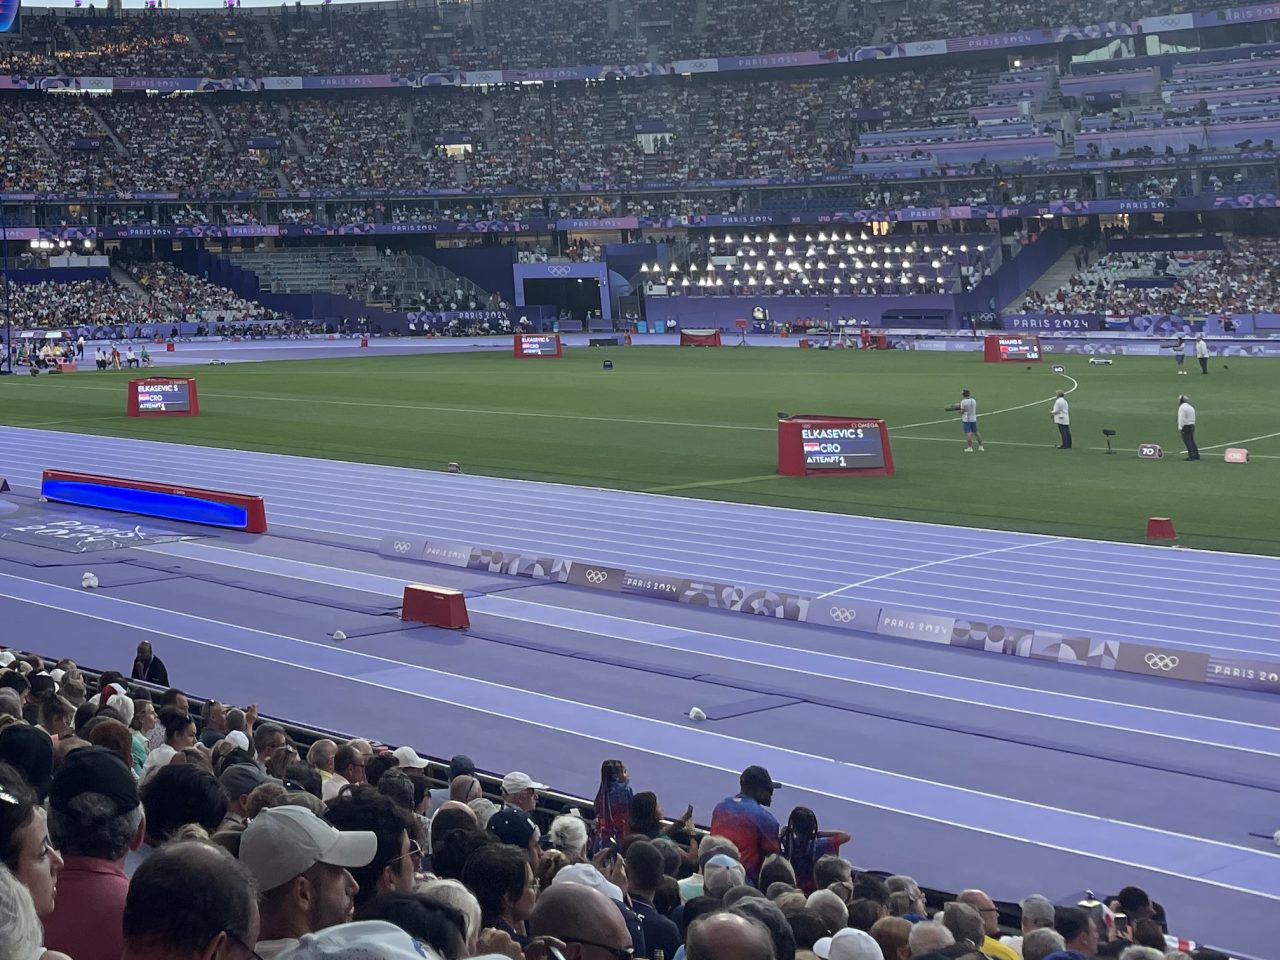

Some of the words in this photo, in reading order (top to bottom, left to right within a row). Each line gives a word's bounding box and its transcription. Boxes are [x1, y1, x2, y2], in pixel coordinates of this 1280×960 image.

[968, 38, 1002, 48] PARIS
[1004, 35, 1032, 45] 2024
[1120, 202, 1148, 210] PARIS
[460, 312, 483, 320] PARIS
[485, 311, 507, 319] 2024
[1014, 320, 1050, 328] PARIS
[1054, 320, 1088, 328] 2024
[138, 385, 172, 393] ELKASEVIC
[173, 384, 178, 392] S
[149, 394, 162, 402] CRO
[801, 428, 856, 439] ELKASEVIC
[857, 428, 864, 438] S
[820, 443, 841, 453] CRO
[806, 456, 839, 464] ATTEMPT
[840, 456, 846, 467] 1
[427, 547, 446, 556] PARIS
[447, 550, 466, 560] 2024
[626, 578, 651, 589] PARIS
[654, 582, 677, 593] 2024
[884, 618, 914, 630] PARIS
[919, 623, 947, 634] 2024
[1215, 665, 1255, 680] PARIS
